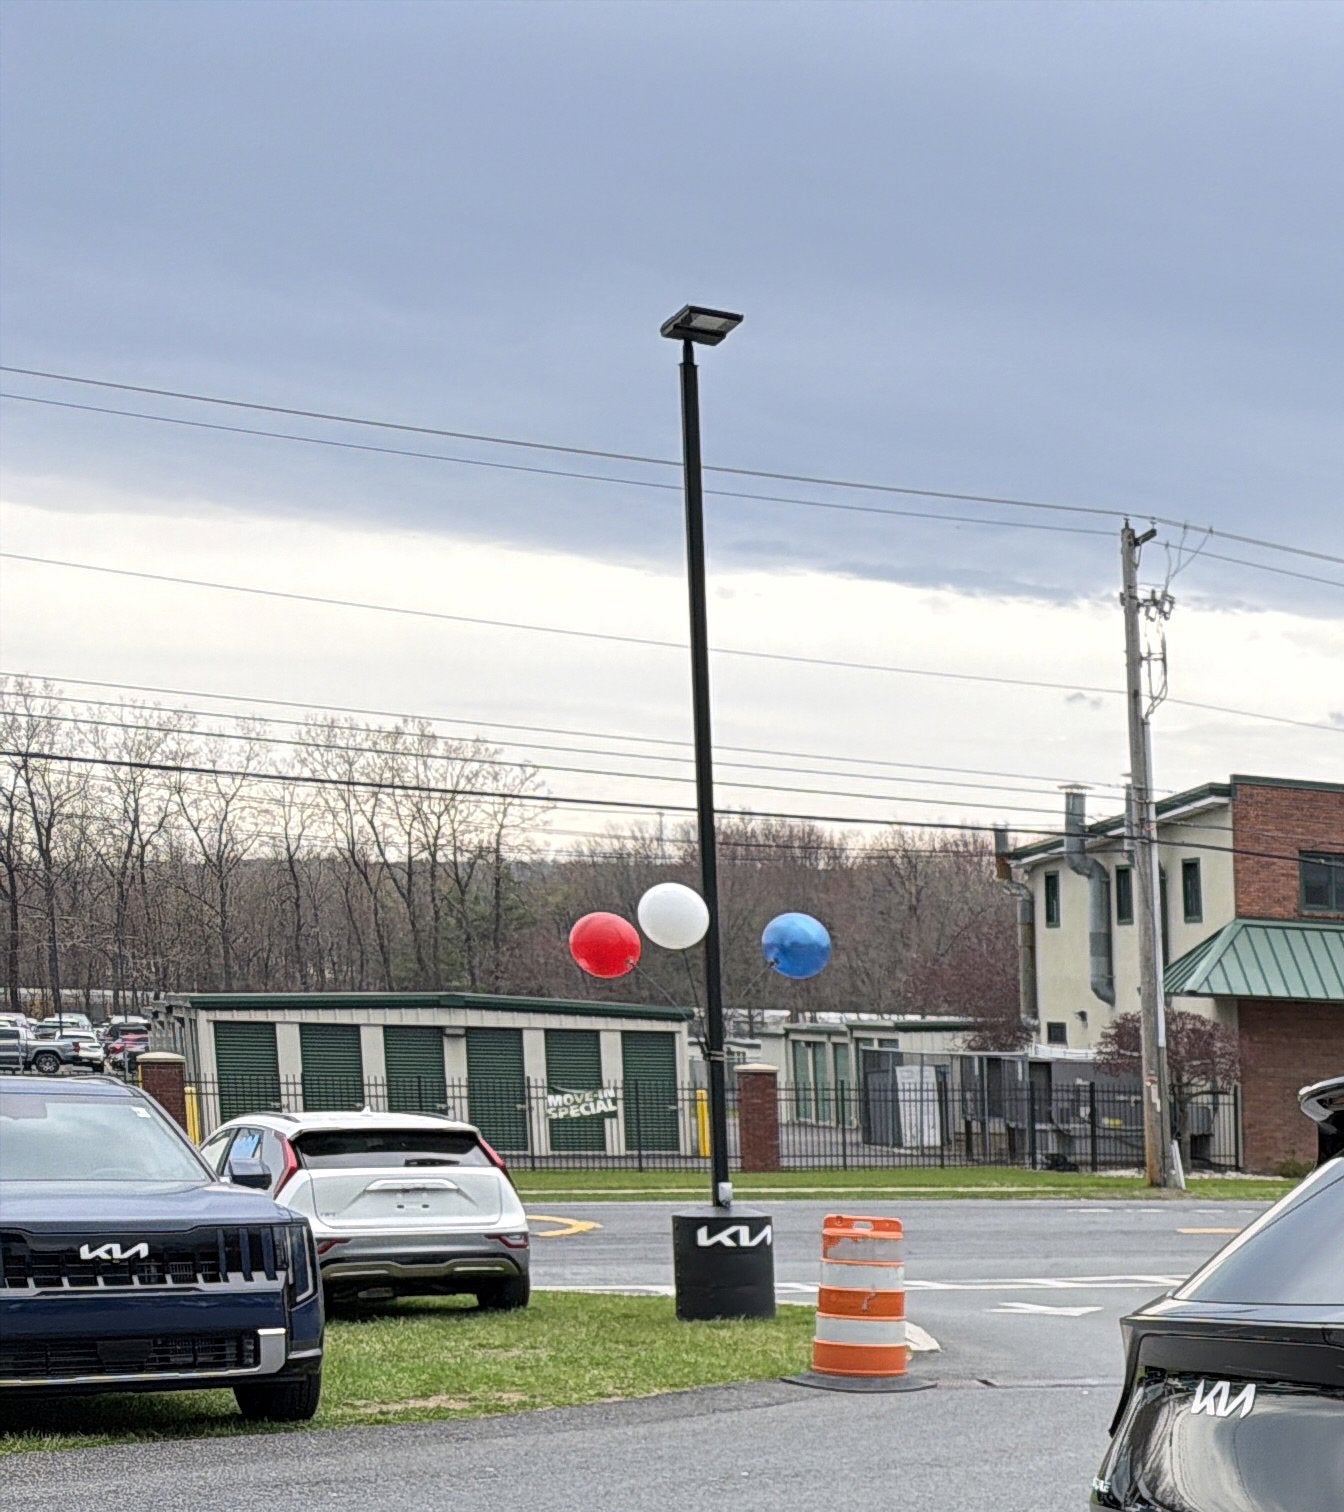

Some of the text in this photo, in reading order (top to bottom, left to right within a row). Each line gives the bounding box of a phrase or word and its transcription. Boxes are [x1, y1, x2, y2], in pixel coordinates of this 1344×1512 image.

[547, 1088, 615, 1107] MOVE-IN
[547, 1099, 617, 1119] SPECIAL
[697, 1224, 772, 1247] KIA
[80, 1242, 149, 1260] KIA
[1190, 1379, 1257, 1418] KIA
